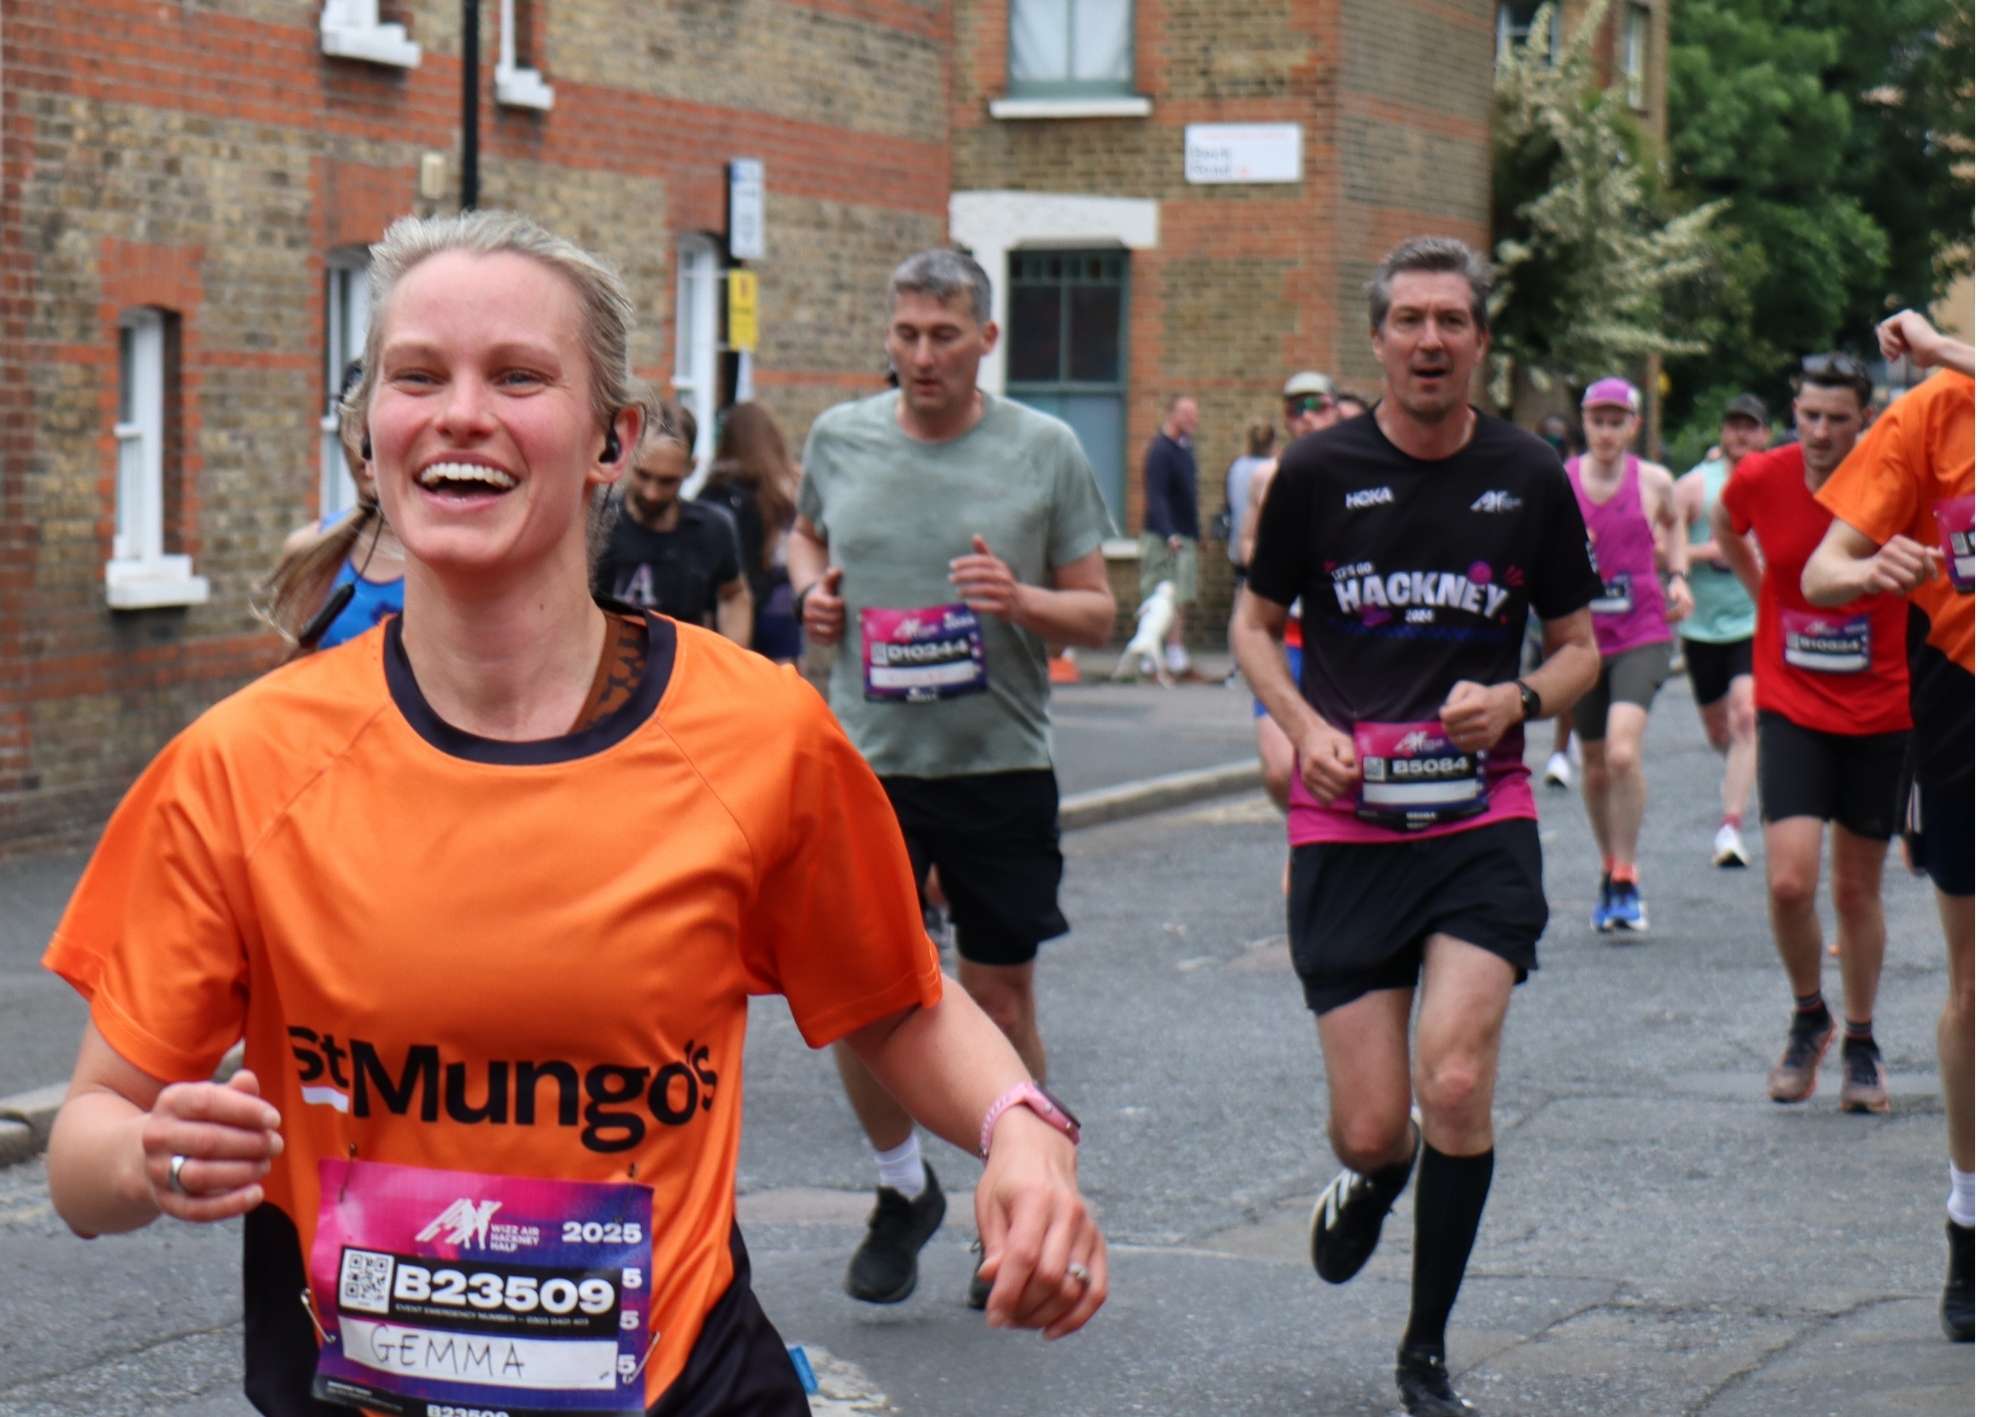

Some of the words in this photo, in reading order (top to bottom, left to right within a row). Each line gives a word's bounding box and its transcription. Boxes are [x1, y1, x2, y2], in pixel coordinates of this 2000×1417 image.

[1346, 486, 1394, 510] HOKA
[1333, 571, 1508, 620] HACKNEY
[1392, 756, 1469, 774] B5084
[562, 1221, 643, 1244] 2025
[393, 1263, 616, 1315] B23509
[622, 1268, 643, 1289] 5
[619, 1310, 640, 1331] 5
[370, 1323, 525, 1377] GEMMA
[617, 1354, 637, 1375] 5
